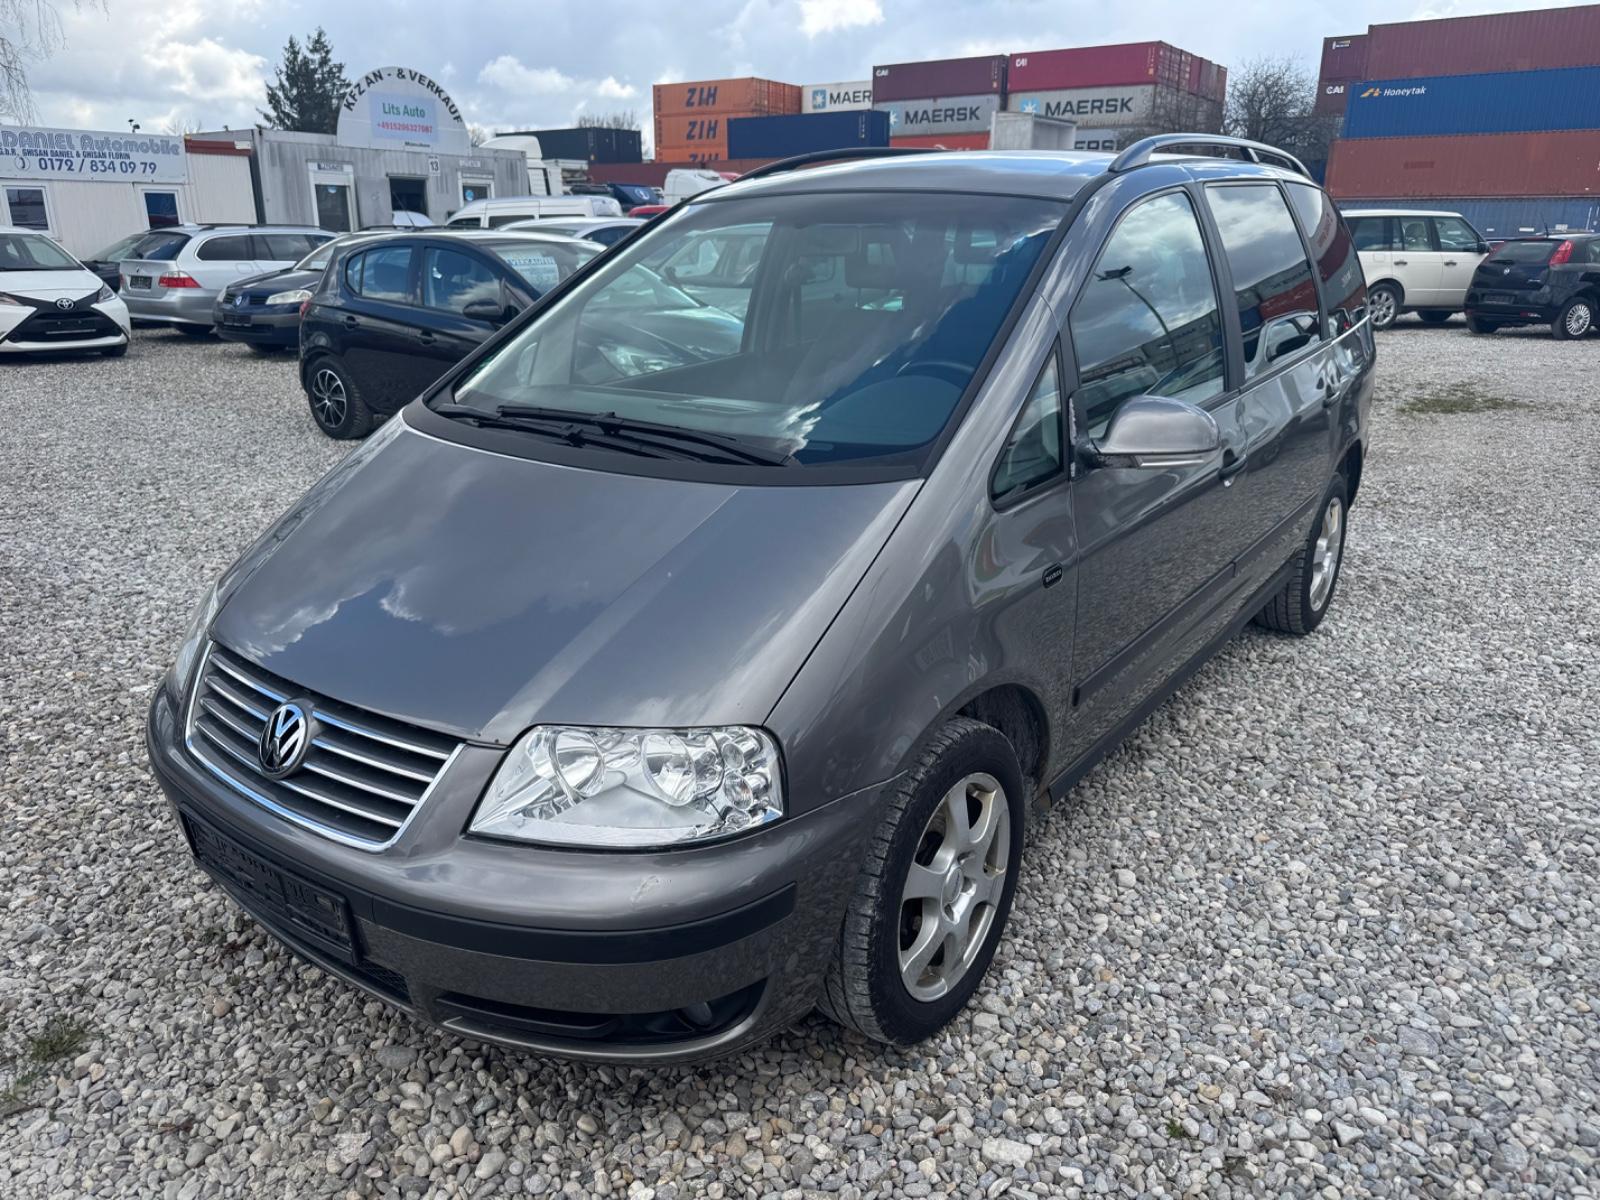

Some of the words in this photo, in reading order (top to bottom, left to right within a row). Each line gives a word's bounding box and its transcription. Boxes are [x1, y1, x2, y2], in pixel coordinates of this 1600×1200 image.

[343, 82, 366, 112] KFZ
[365, 69, 383, 88] AN
[397, 68, 406, 80] &
[409, 69, 463, 123] VERKAUF
[1326, 85, 1345, 95] CAI
[1383, 85, 1427, 97] Honeytak
[382, 102, 401, 116] Lits
[403, 104, 426, 118] Auto
[904, 106, 980, 125] MAERSK
[1044, 97, 1134, 117] MAERSK
[1, 130, 75, 150] DANIEL
[80, 134, 180, 156] Automobile
[38, 157, 75, 171] 0172
[79, 159, 85, 173] /
[90, 160, 116, 173] 834
[119, 161, 136, 174] 09
[140, 162, 157, 174] 79
[430, 160, 439, 172] 13
